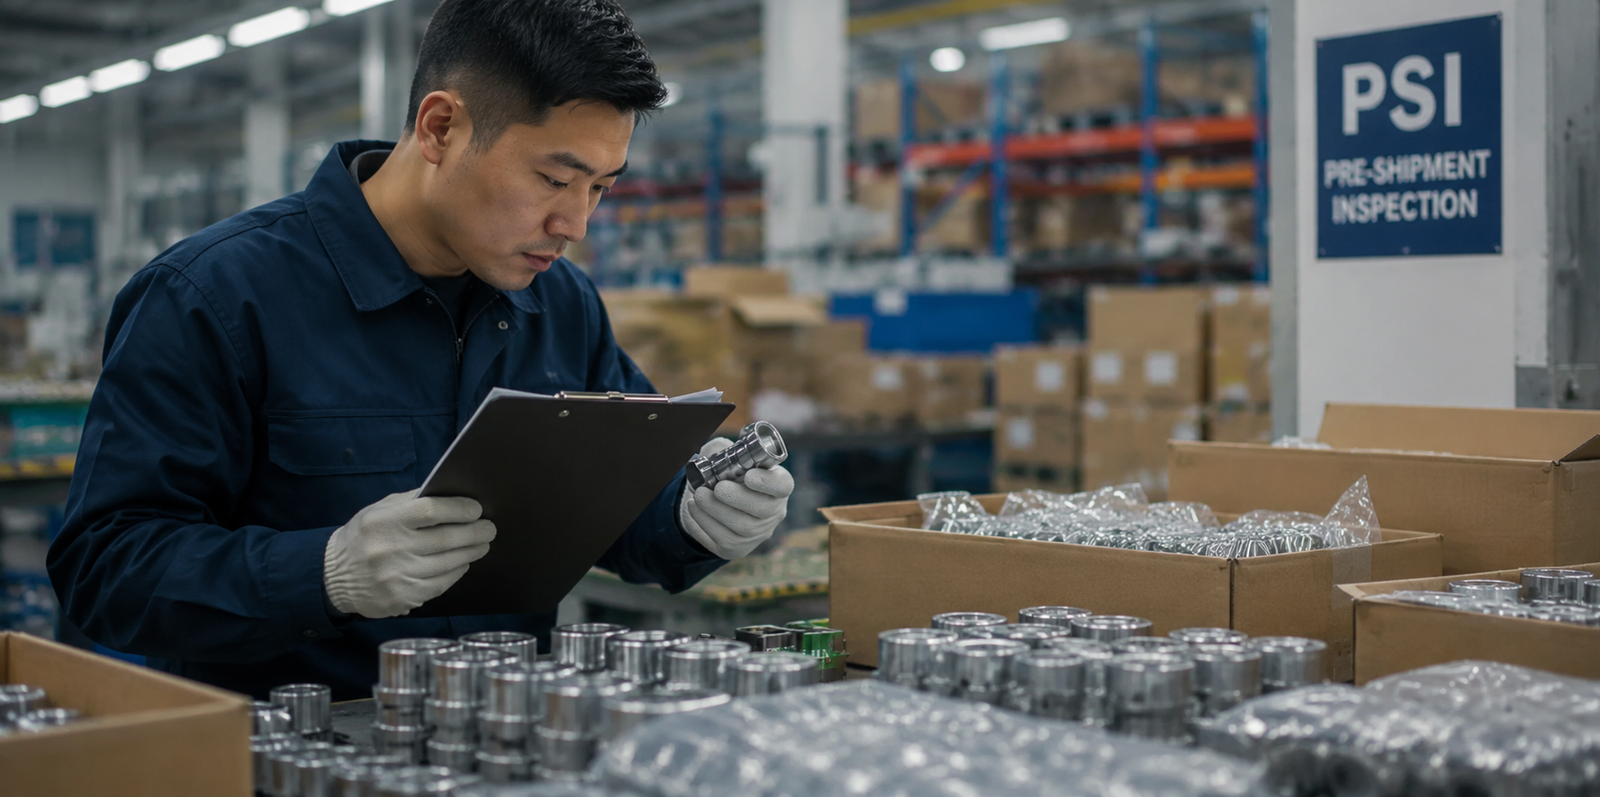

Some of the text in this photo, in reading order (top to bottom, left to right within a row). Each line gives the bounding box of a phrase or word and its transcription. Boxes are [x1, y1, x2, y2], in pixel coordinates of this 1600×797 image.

[1342, 52, 1461, 136] PSI
[1324, 149, 1491, 188] PRE-SHIPMENT
[1332, 188, 1478, 224] INSPECTION
